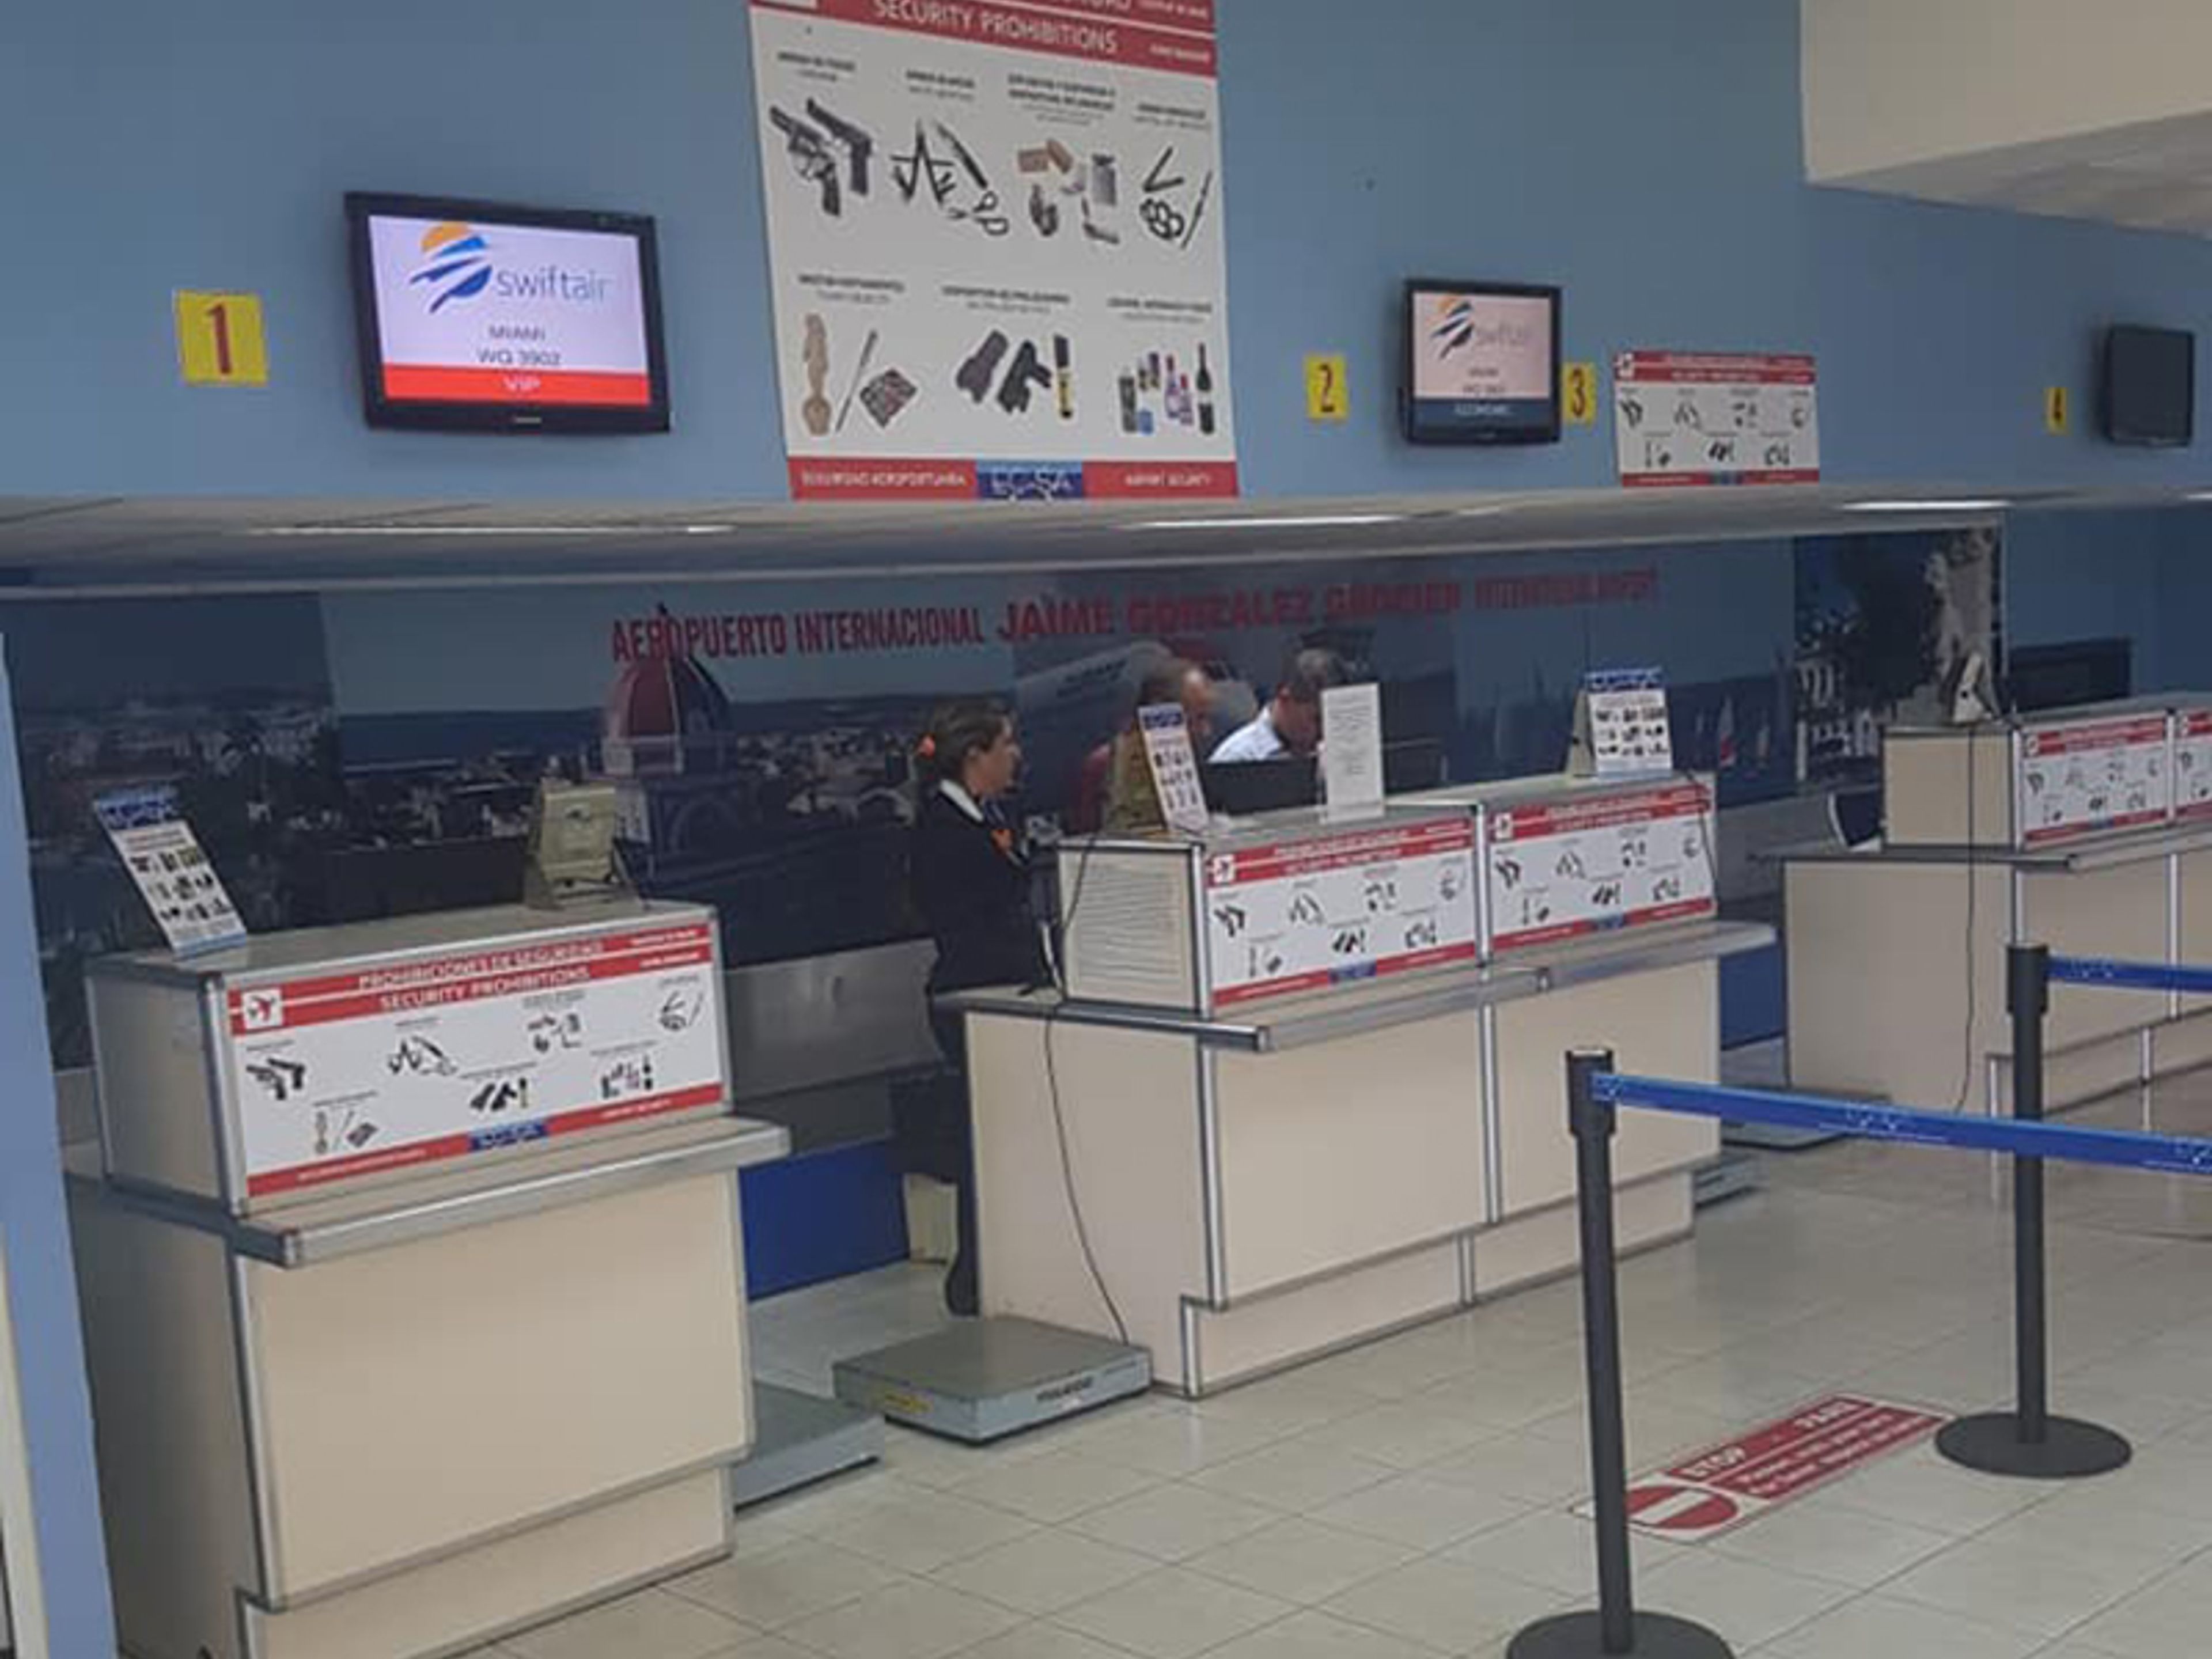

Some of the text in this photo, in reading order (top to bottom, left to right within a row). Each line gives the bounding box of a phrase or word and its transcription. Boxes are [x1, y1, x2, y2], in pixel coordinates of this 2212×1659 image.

[874, 0, 974, 31] SECURITY
[981, 10, 1119, 55] PROHIBITIONS
[206, 304, 233, 376] 1
[1316, 363, 1336, 413] 2
[1568, 368, 1586, 417] 3
[612, 613, 787, 662] AEROPUERTO
[794, 608, 984, 654] INTERNACIONAL
[996, 598, 1114, 641] JAIME
